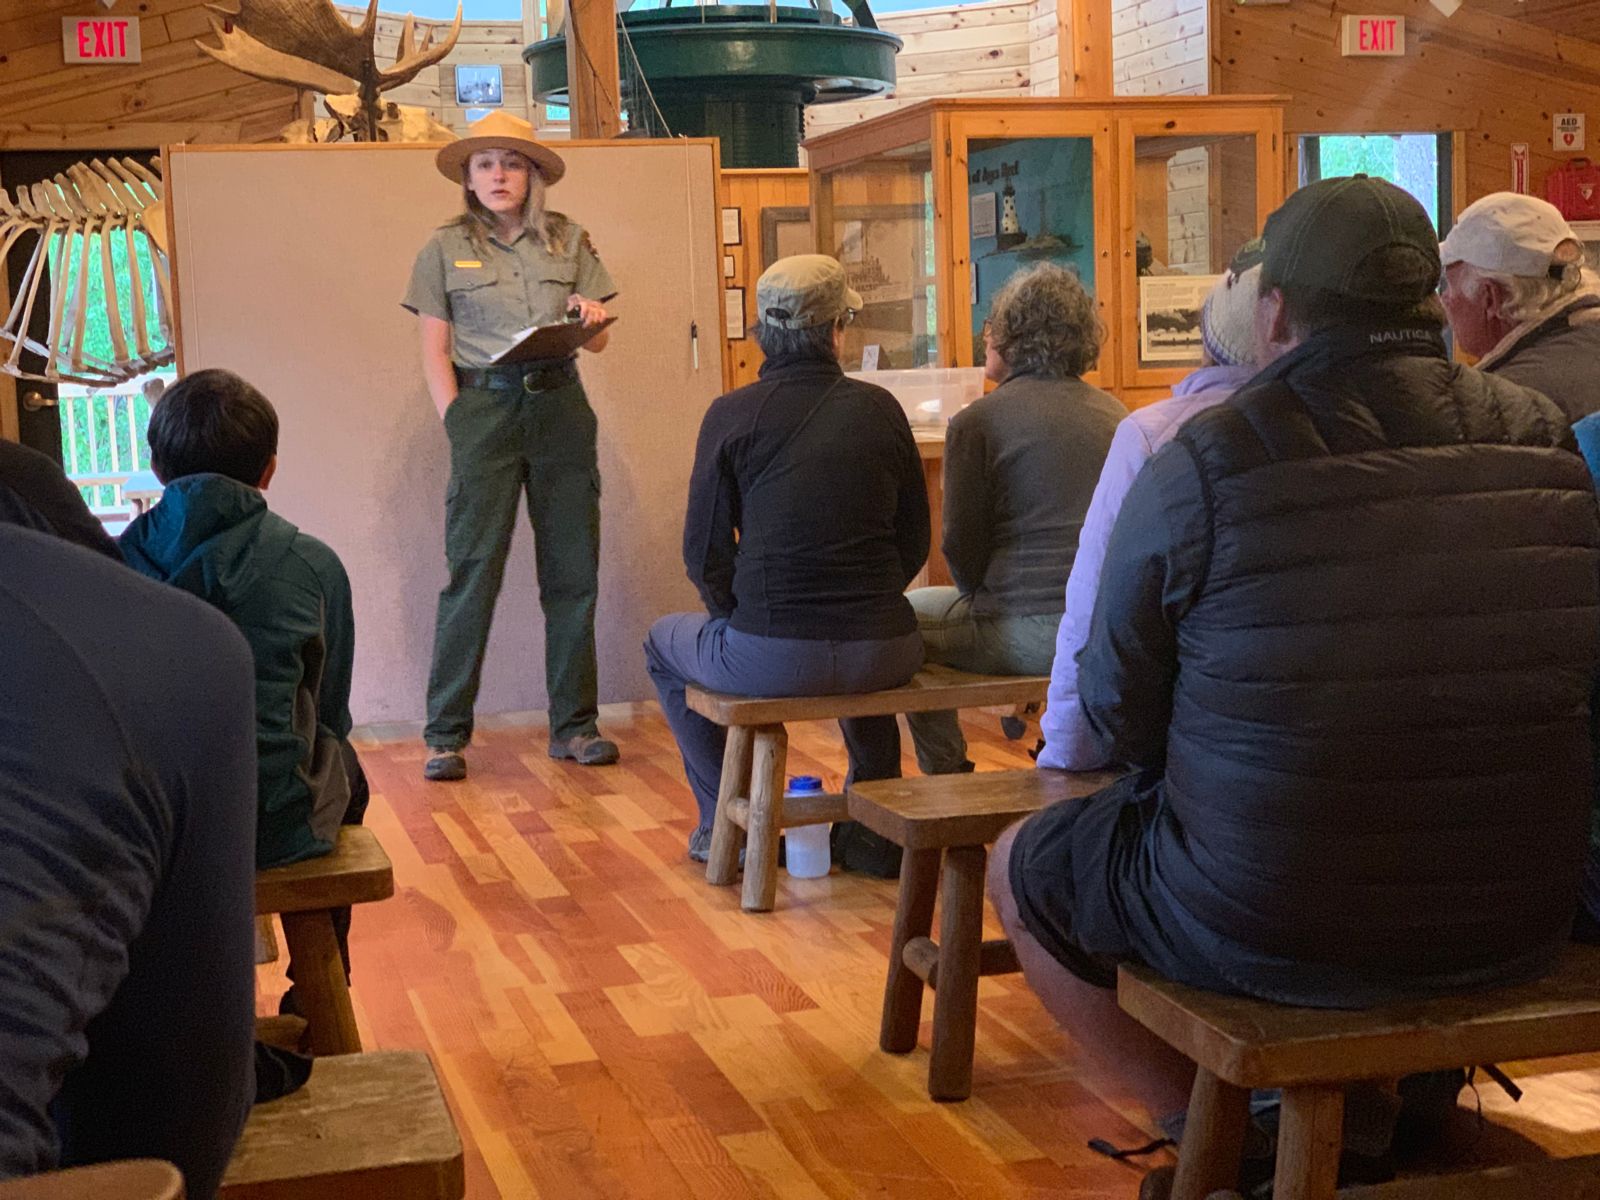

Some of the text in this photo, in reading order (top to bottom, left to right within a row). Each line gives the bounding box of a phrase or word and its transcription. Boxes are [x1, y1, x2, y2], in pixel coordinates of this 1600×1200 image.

[77, 21, 129, 58] EXIT
[1359, 20, 1397, 51] EXIT
[1561, 117, 1578, 126] AED
[1368, 328, 1434, 344] NAUTICA
